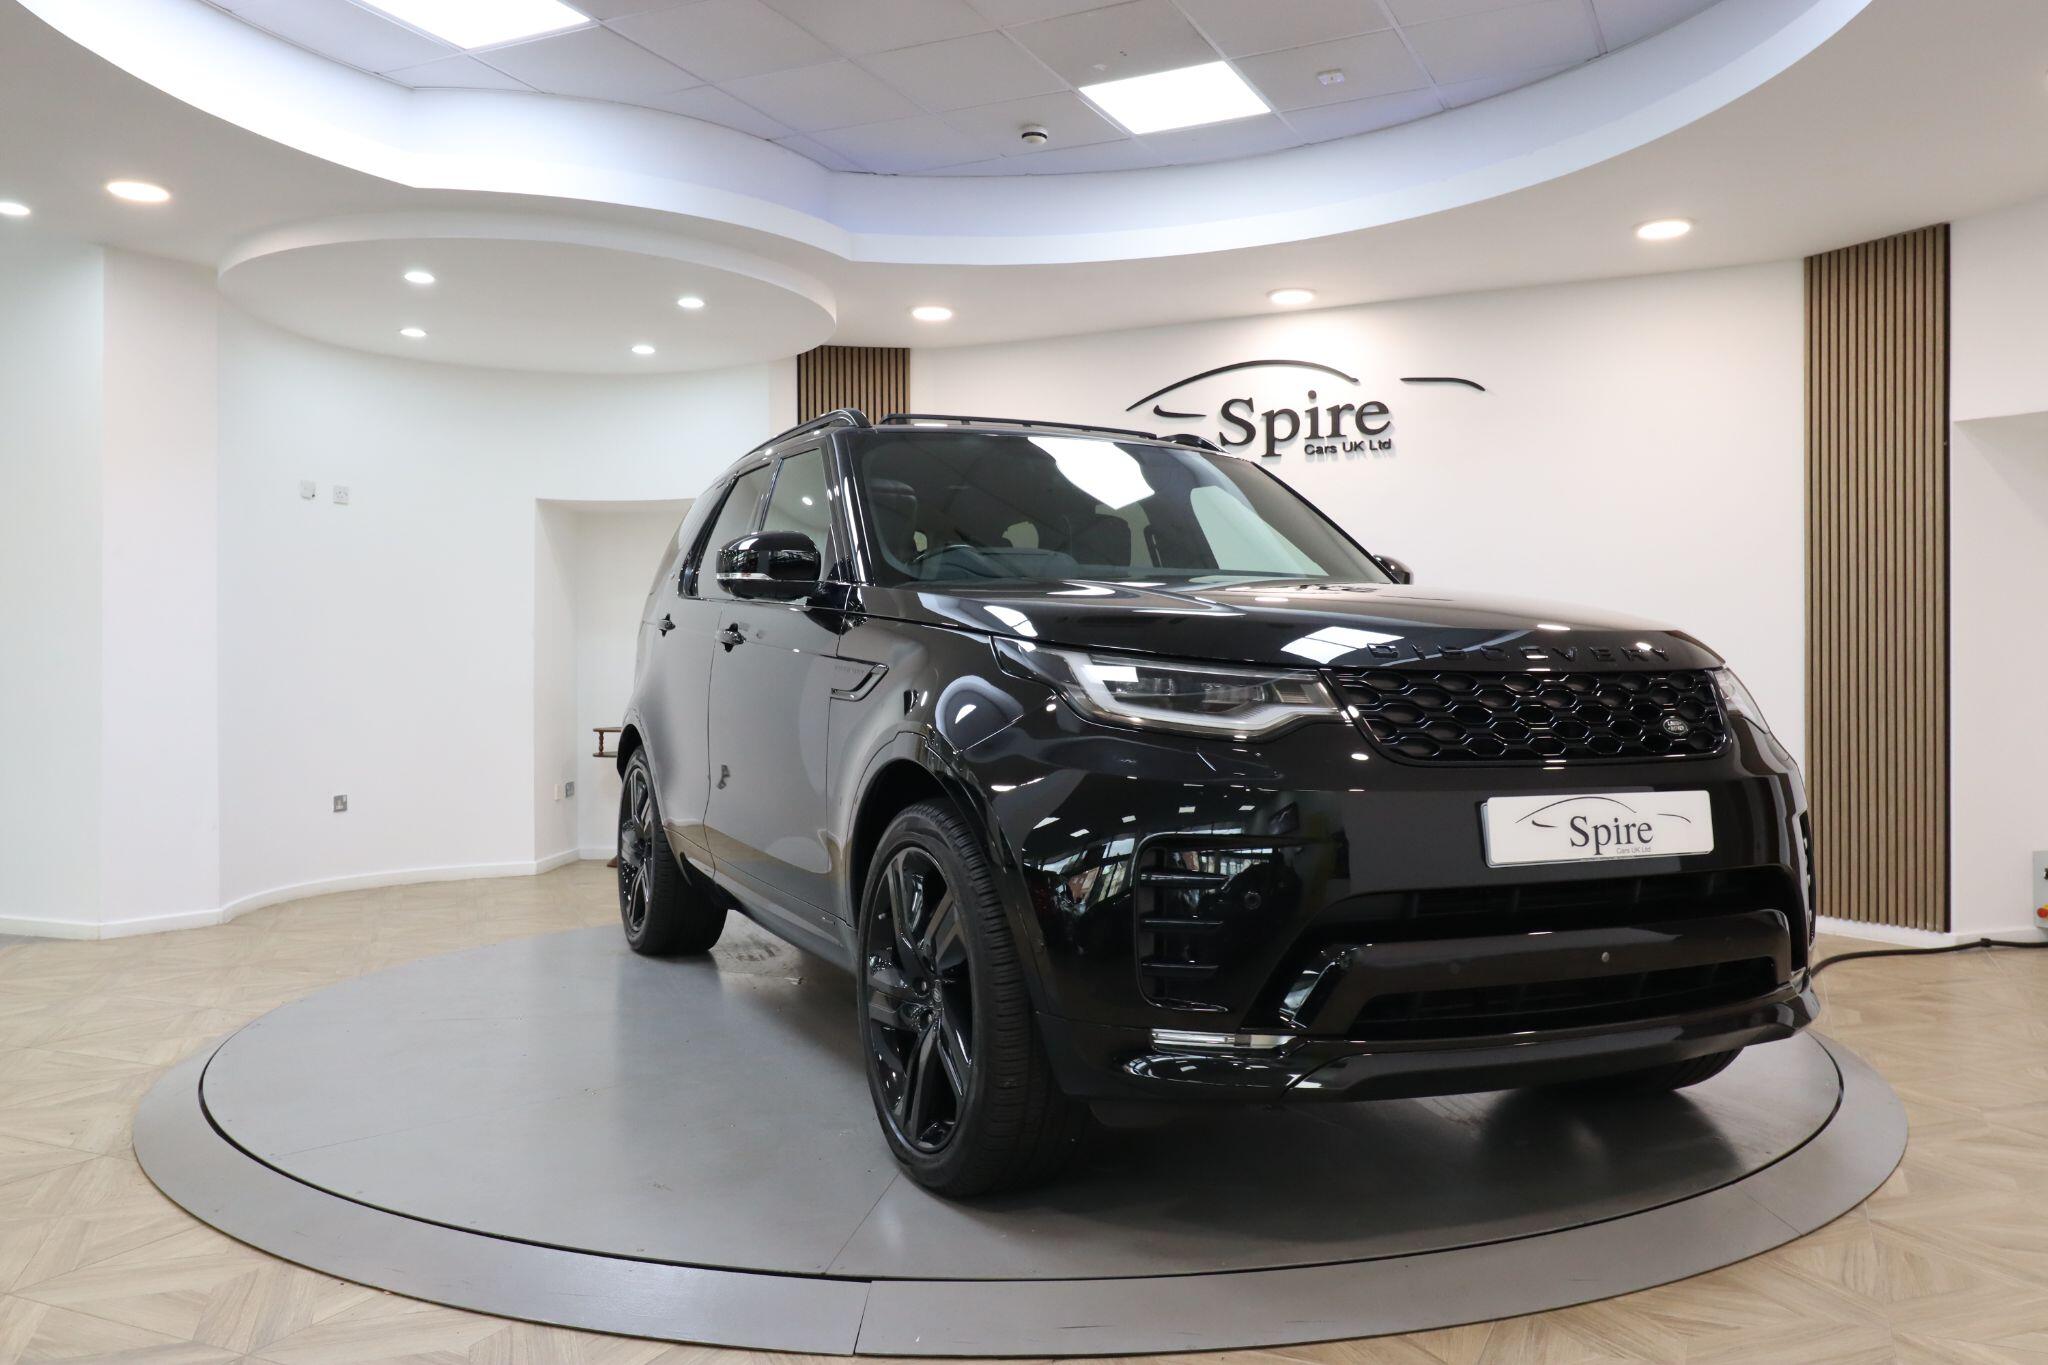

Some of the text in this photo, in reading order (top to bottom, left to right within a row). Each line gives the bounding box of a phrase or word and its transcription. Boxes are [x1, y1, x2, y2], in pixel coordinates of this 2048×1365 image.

[1218, 389, 1391, 458] Spire
[1304, 438, 1392, 456] Cars UK Ltd
[1569, 815, 1654, 856] Spire
[1616, 847, 1630, 855] Cars
[1631, 846, 1641, 854] UK
